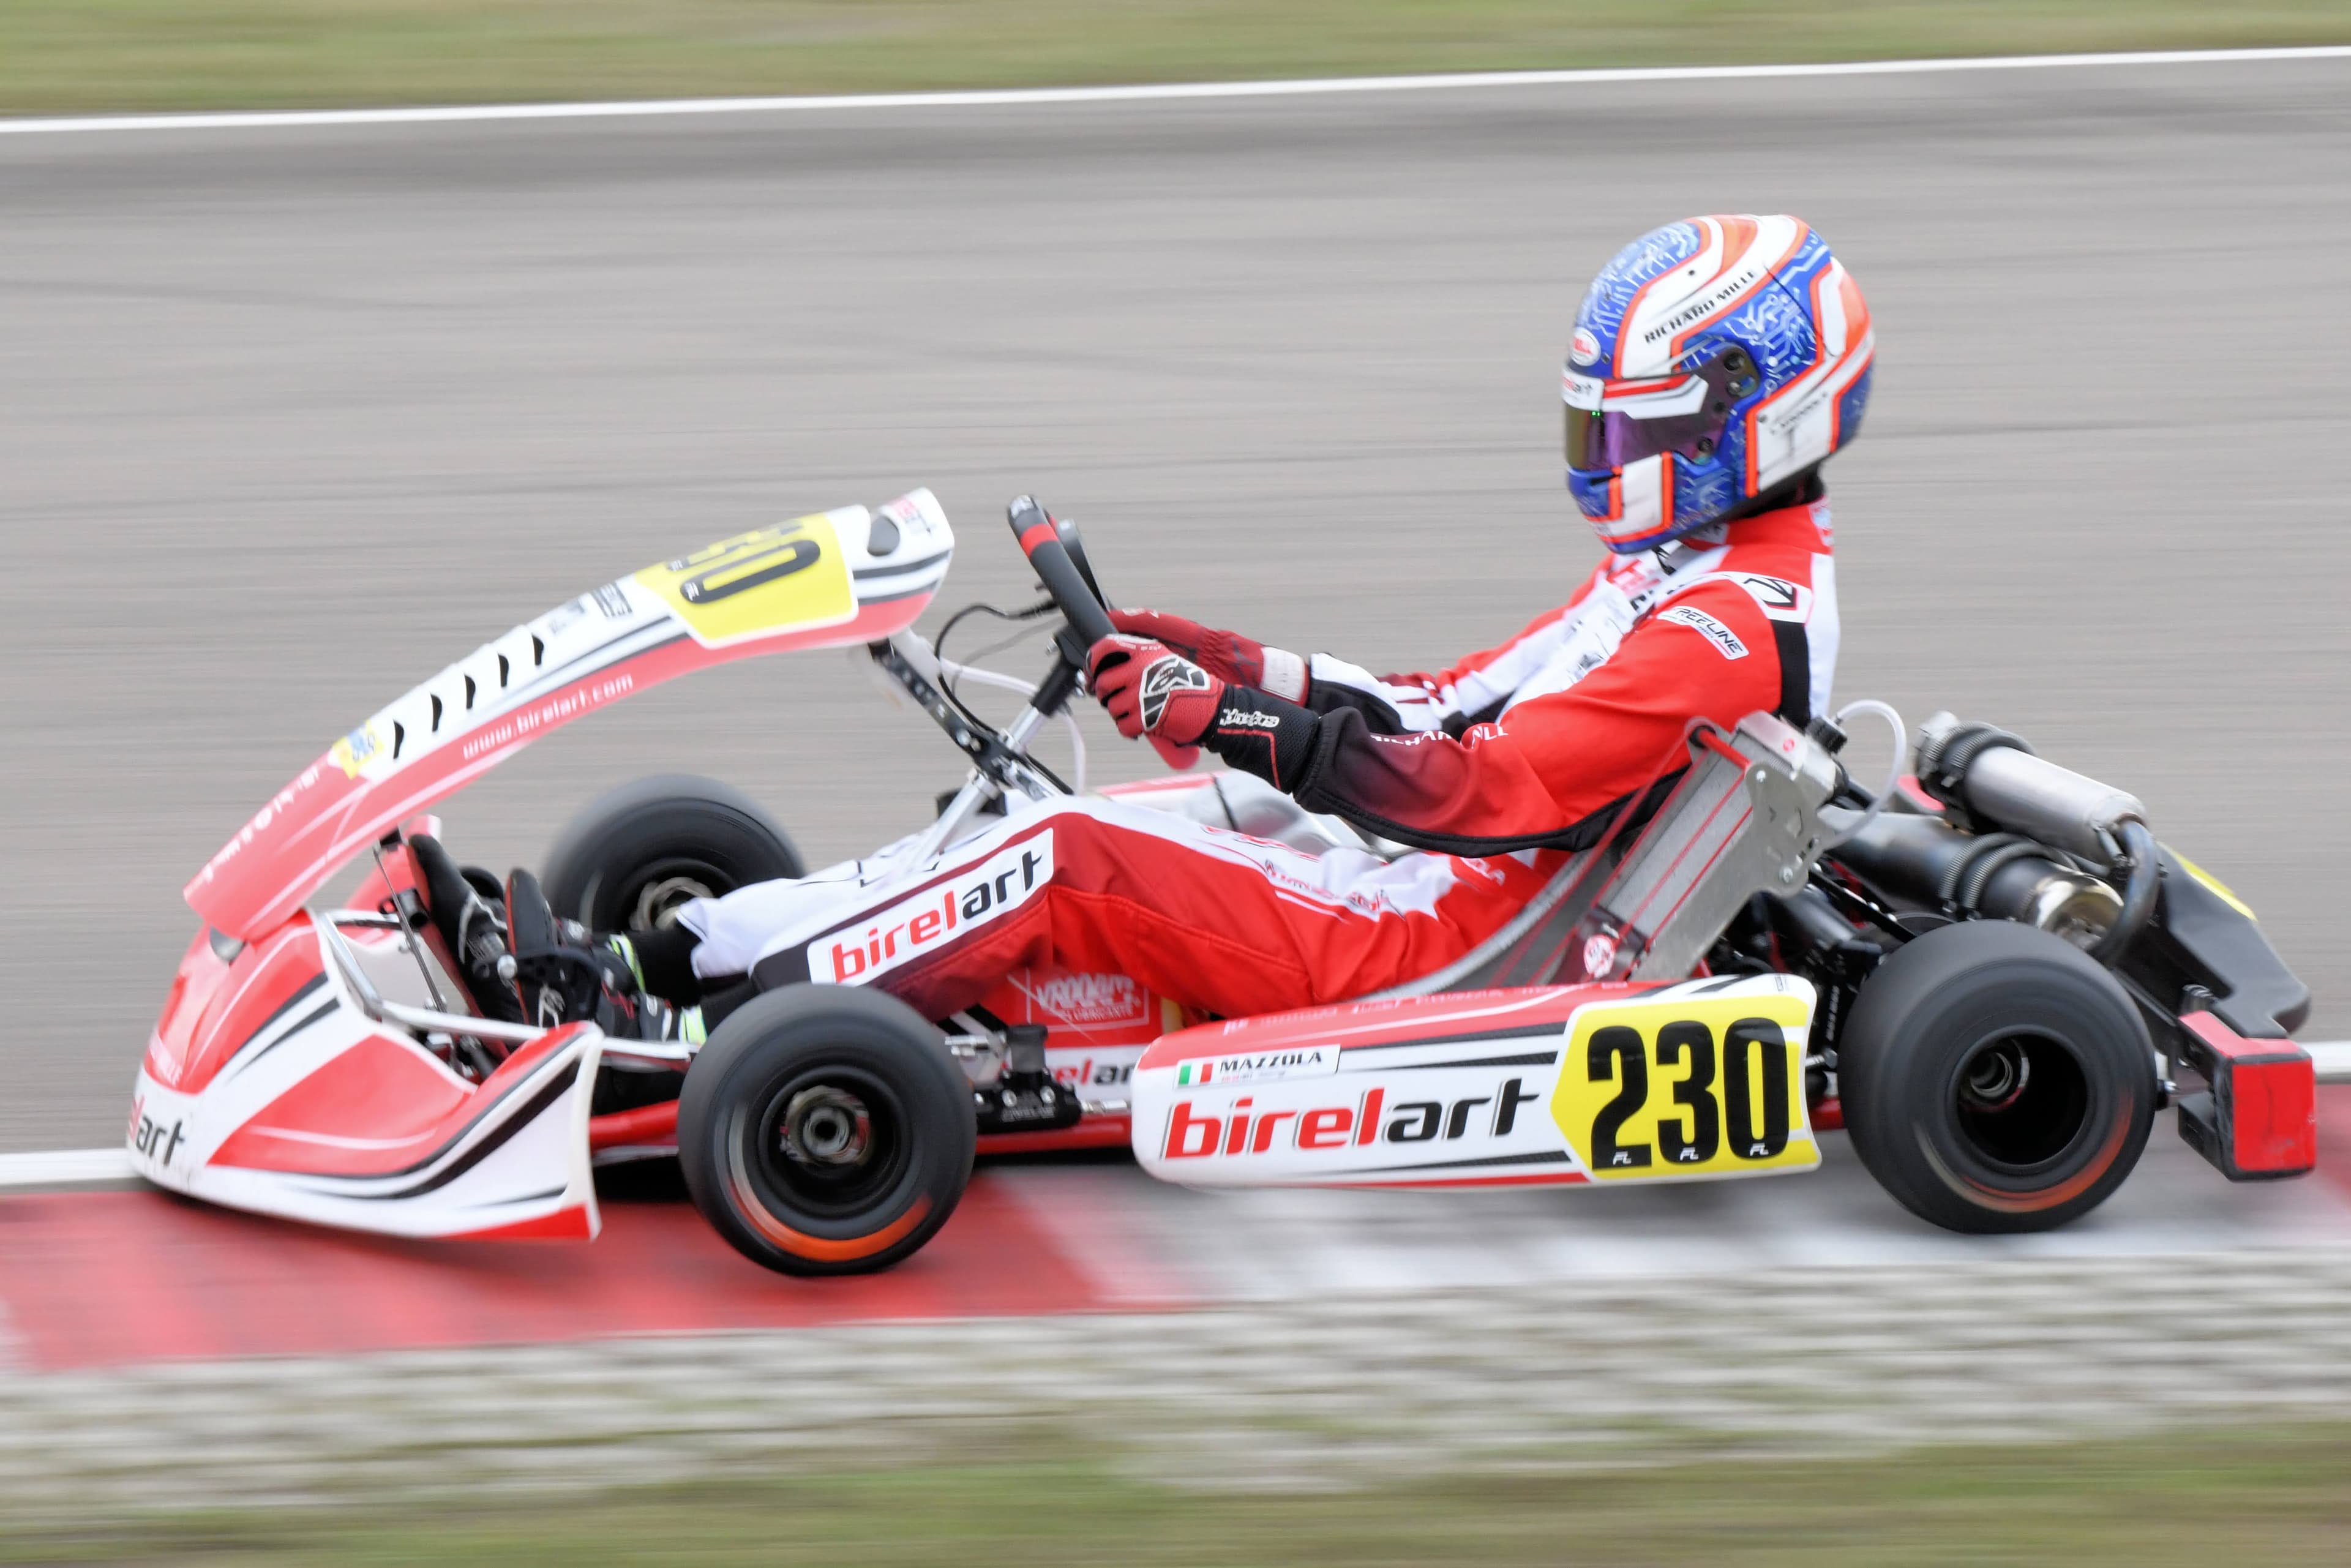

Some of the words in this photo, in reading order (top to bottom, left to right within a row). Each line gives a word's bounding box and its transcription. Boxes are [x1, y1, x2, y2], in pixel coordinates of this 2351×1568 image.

[1674, 607, 1744, 654] REELINE
[463, 673, 633, 760] www.birelart.com
[830, 850, 1043, 985] birelart
[1220, 1051, 1322, 1073] MAZZOLA
[1587, 1017, 1790, 1170] 230
[1161, 1078, 1540, 1160] birelart
